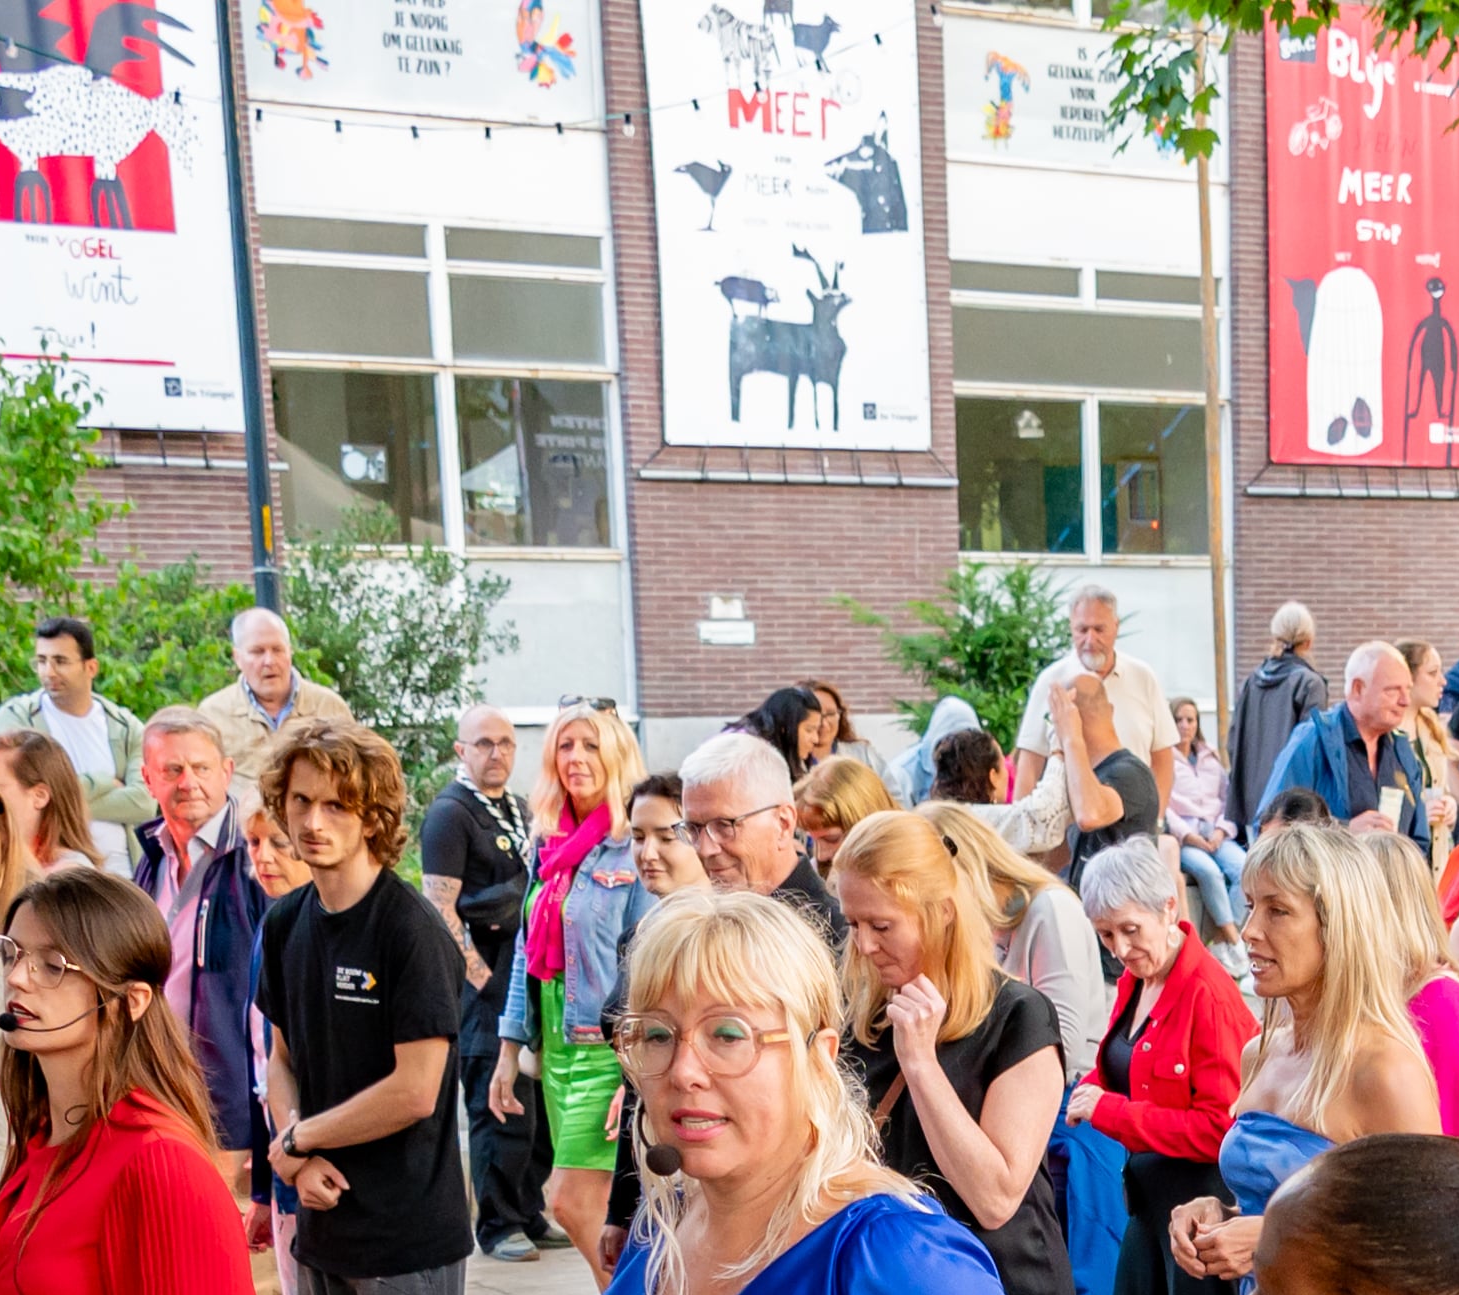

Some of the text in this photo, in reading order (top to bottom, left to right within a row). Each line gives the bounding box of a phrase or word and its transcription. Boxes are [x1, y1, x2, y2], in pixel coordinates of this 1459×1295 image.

[382, 31, 402, 49] OM
[397, 56, 410, 73] TE
[1338, 165, 1413, 207] MEER
